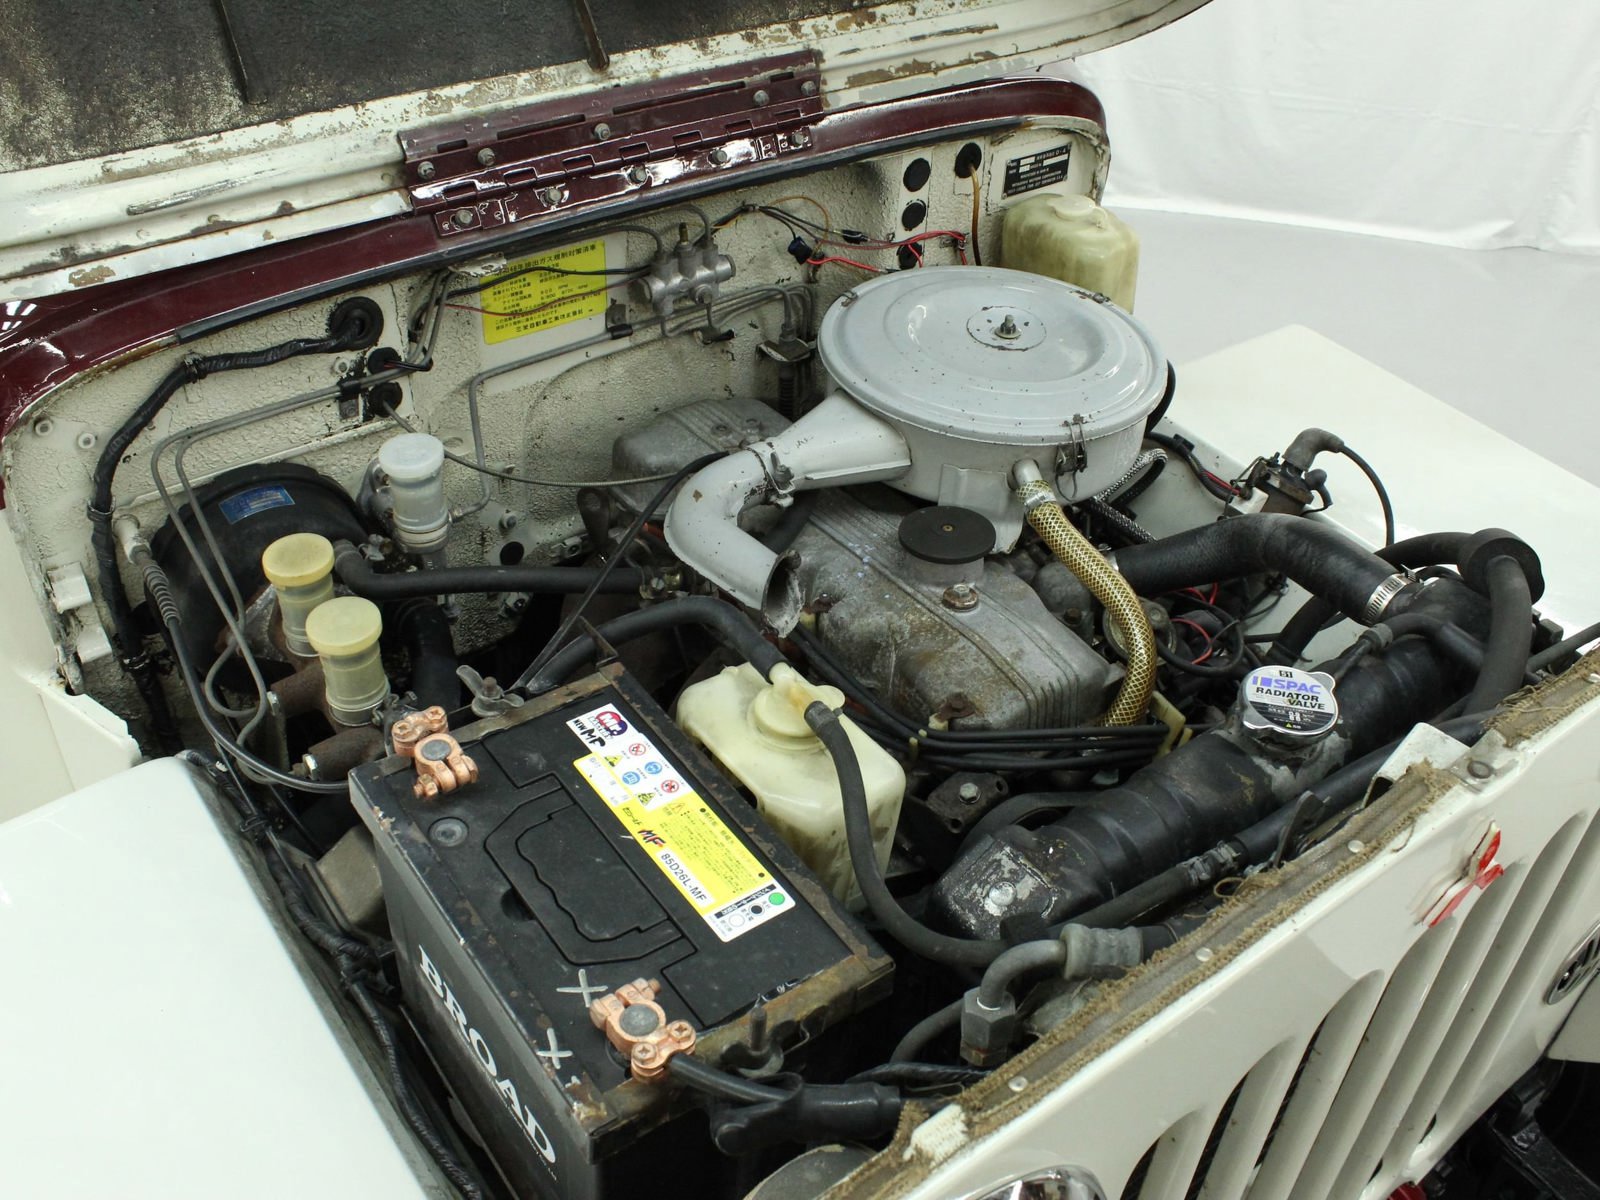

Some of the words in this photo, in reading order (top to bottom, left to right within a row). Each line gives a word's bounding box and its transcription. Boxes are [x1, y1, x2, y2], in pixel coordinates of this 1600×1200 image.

[1256, 687, 1319, 702] RADIATOR
[1288, 699, 1325, 710] VALVE
[573, 719, 587, 731] NEW
[661, 853, 708, 901] 85D26L-MF
[419, 944, 556, 1163] BROAD
